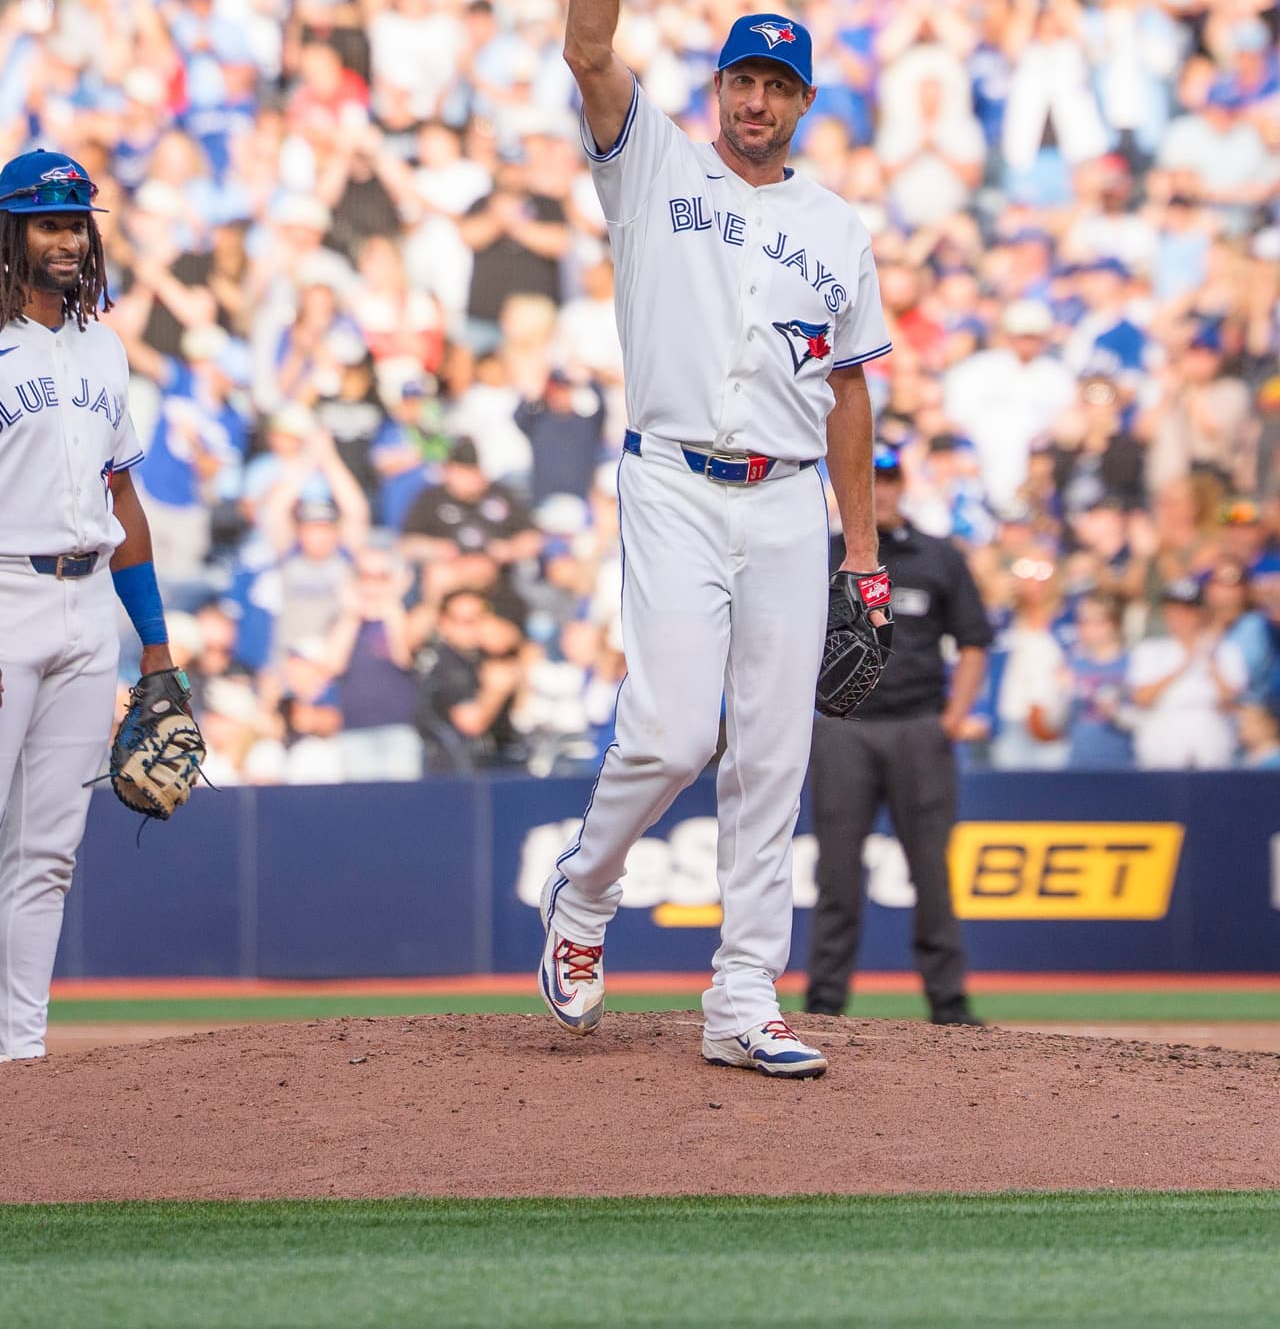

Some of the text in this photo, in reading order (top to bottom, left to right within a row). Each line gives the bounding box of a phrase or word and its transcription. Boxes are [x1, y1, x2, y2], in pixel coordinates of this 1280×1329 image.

[762, 232, 848, 313] JAYS
[749, 465, 766, 481] 31
[970, 844, 1154, 899] BET
